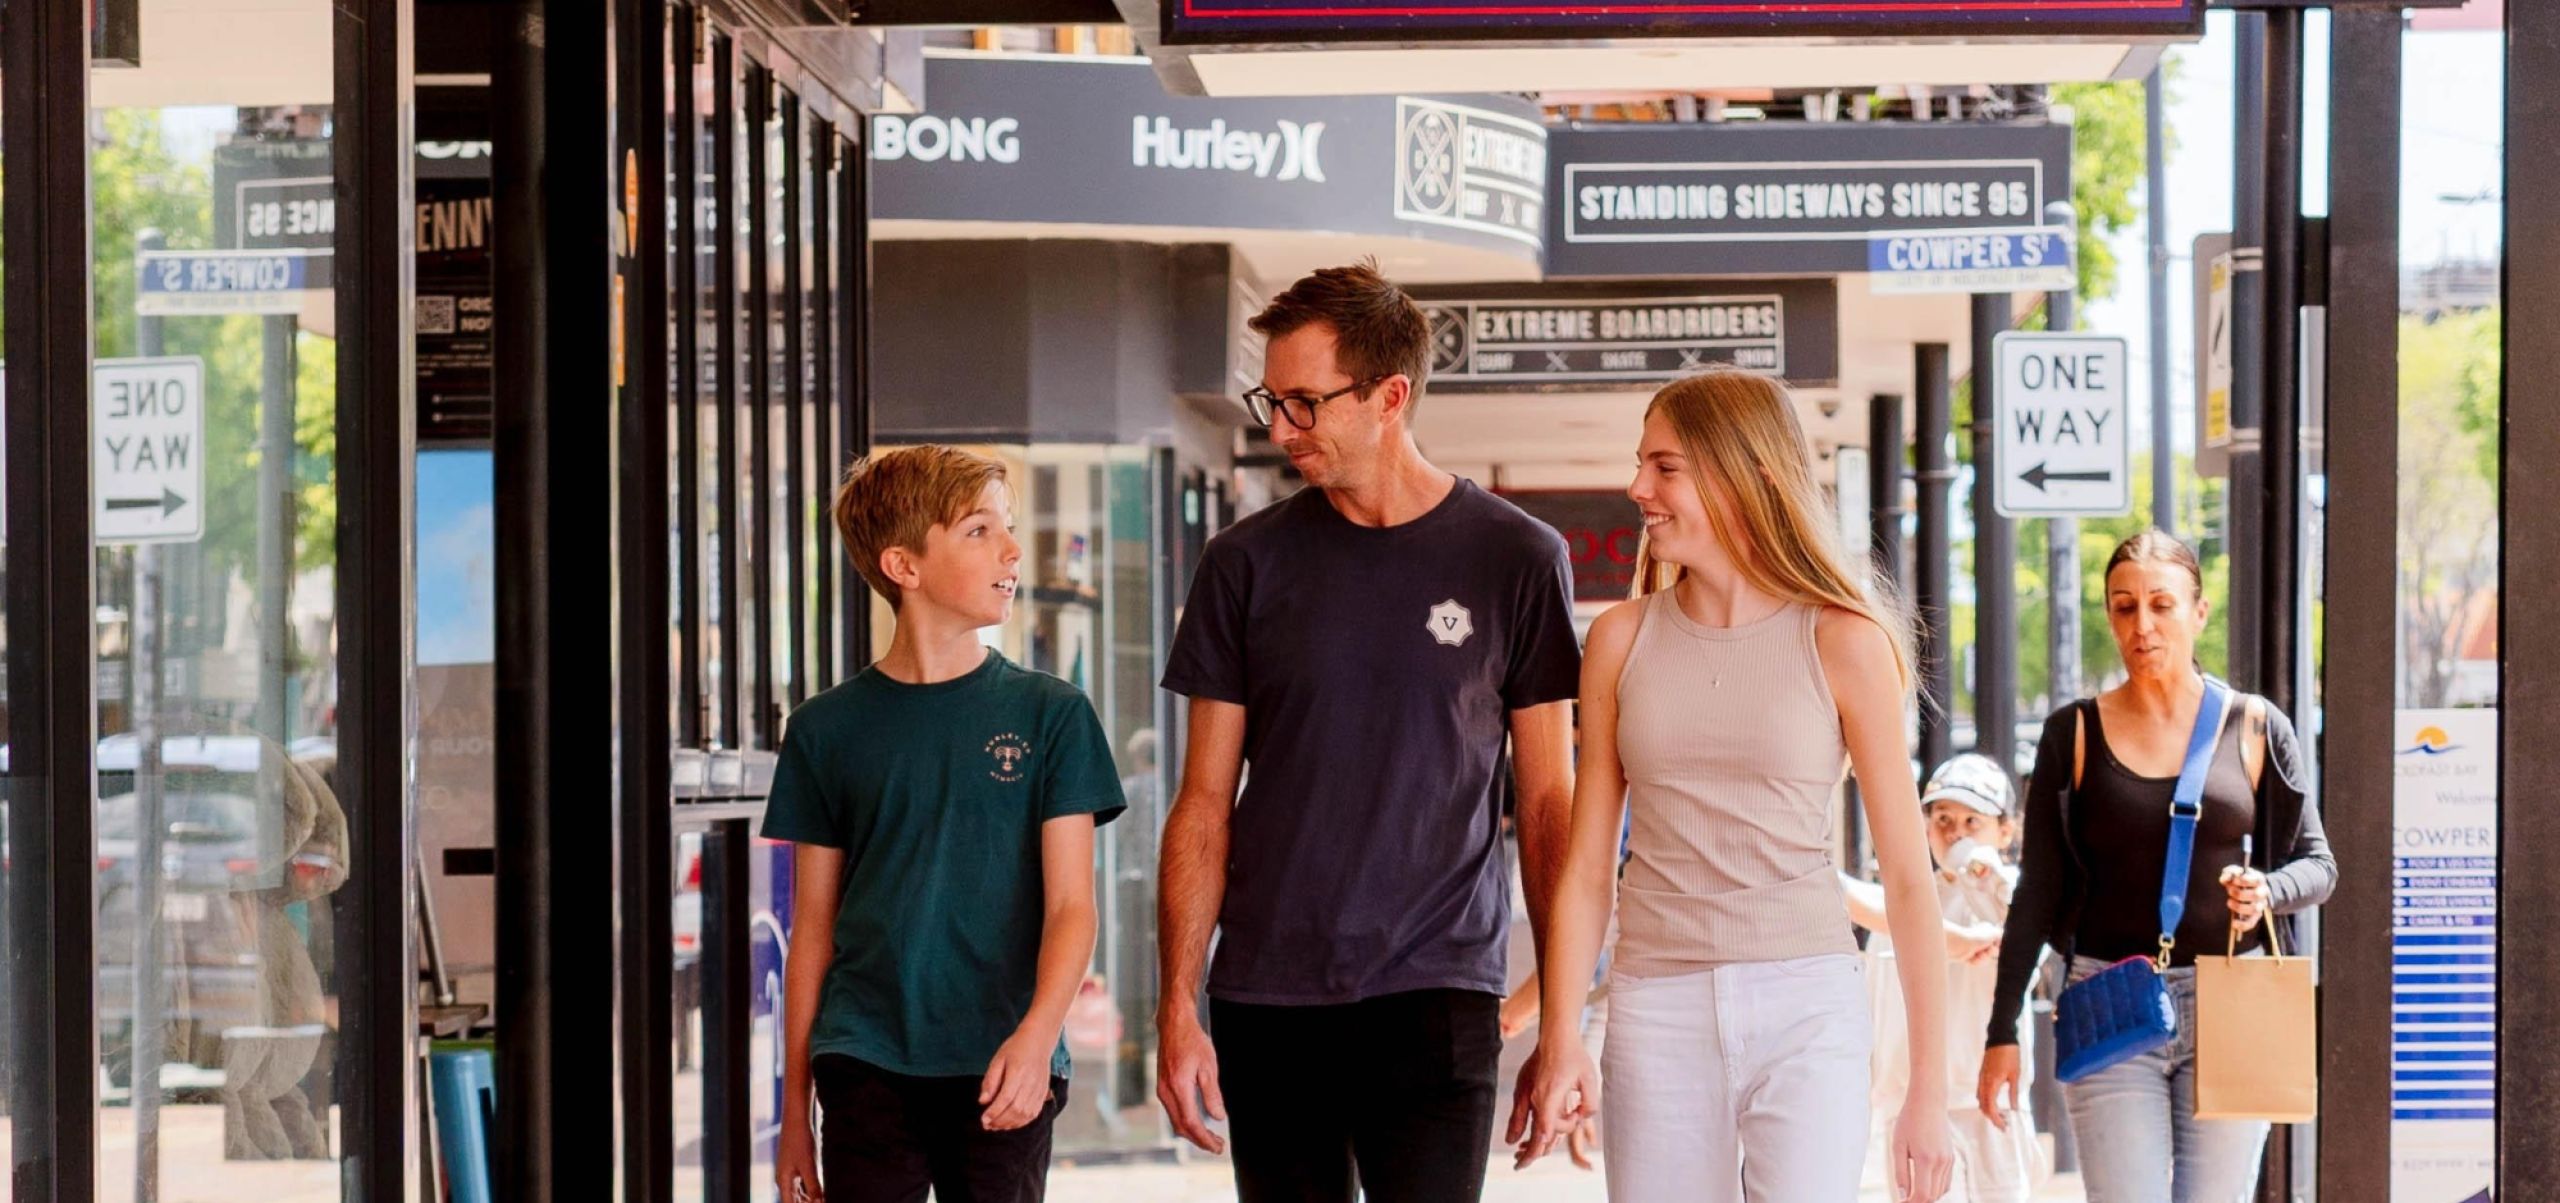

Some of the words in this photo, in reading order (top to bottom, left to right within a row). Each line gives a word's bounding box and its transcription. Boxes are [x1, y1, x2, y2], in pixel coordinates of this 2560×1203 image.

[868, 115, 1020, 163] BONG
[1132, 115, 1281, 178] Hurley
[1579, 184, 1728, 220] STANDING
[1734, 182, 1885, 219] SIDEWAYS
[1892, 181, 1981, 217] SINCE
[1987, 181, 2028, 216] 95
[1887, 236, 2012, 271] COWPER
[1476, 311, 1594, 340] EXTREME
[1601, 305, 1776, 338] BOARDRIDERS
[2021, 354, 2106, 391] ONE
[2014, 409, 2112, 444] WAY
